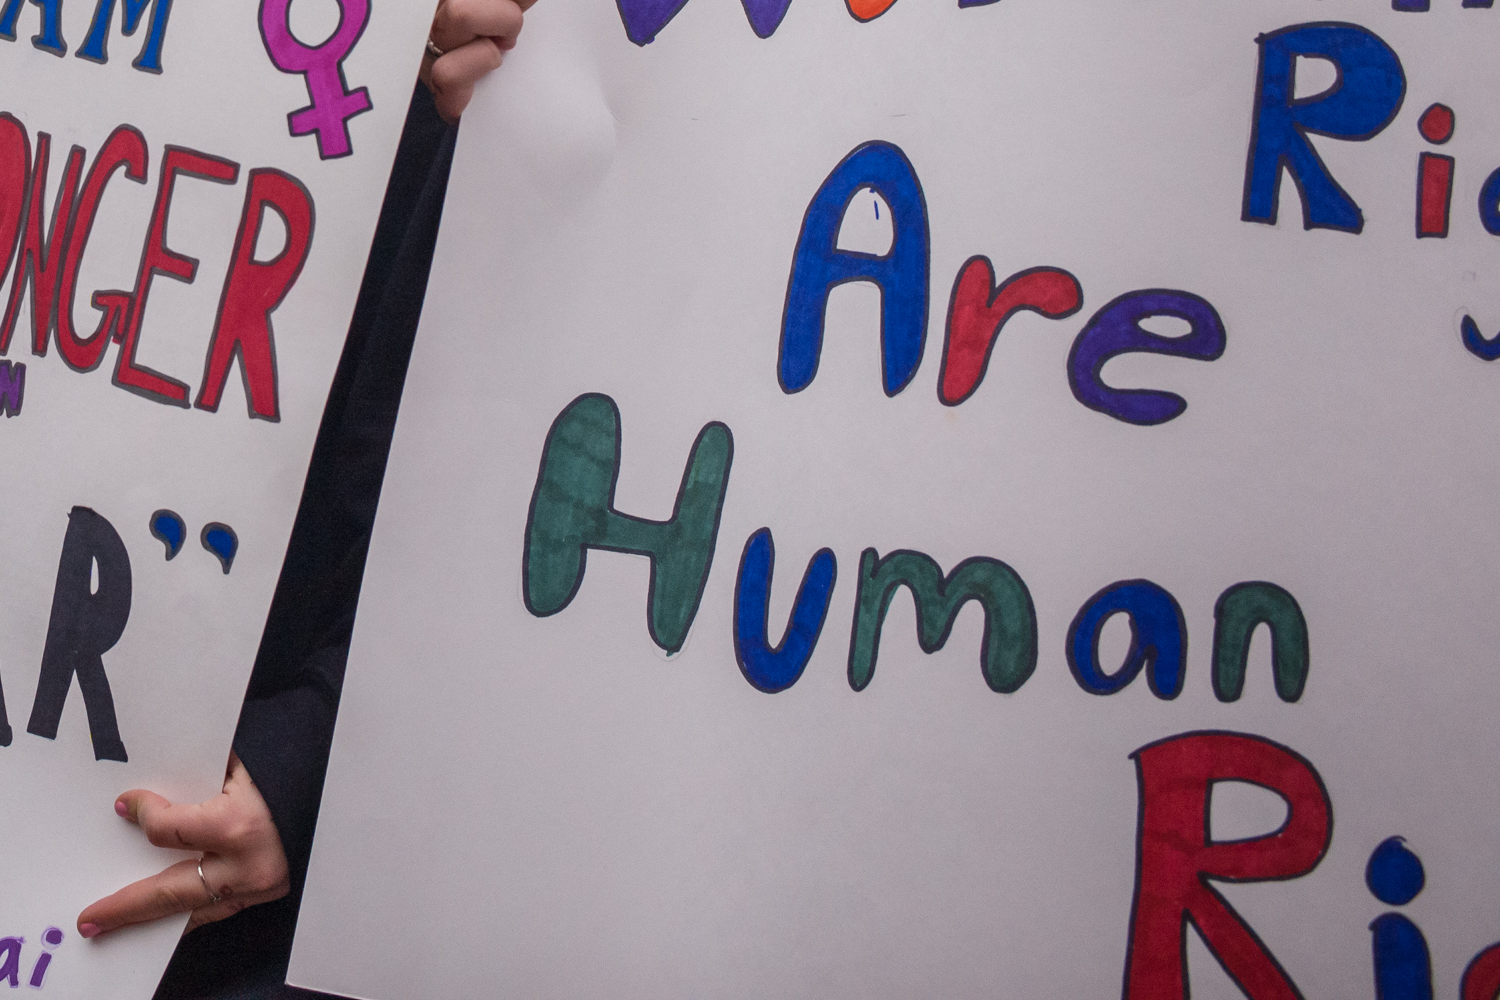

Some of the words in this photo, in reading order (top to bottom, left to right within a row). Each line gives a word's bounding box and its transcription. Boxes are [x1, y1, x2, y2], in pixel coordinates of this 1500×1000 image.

[777, 140, 1227, 426] Are
[1241, 21, 1500, 362] Ri
[522, 392, 1310, 704] Human
[1121, 730, 1500, 1000] Ri
